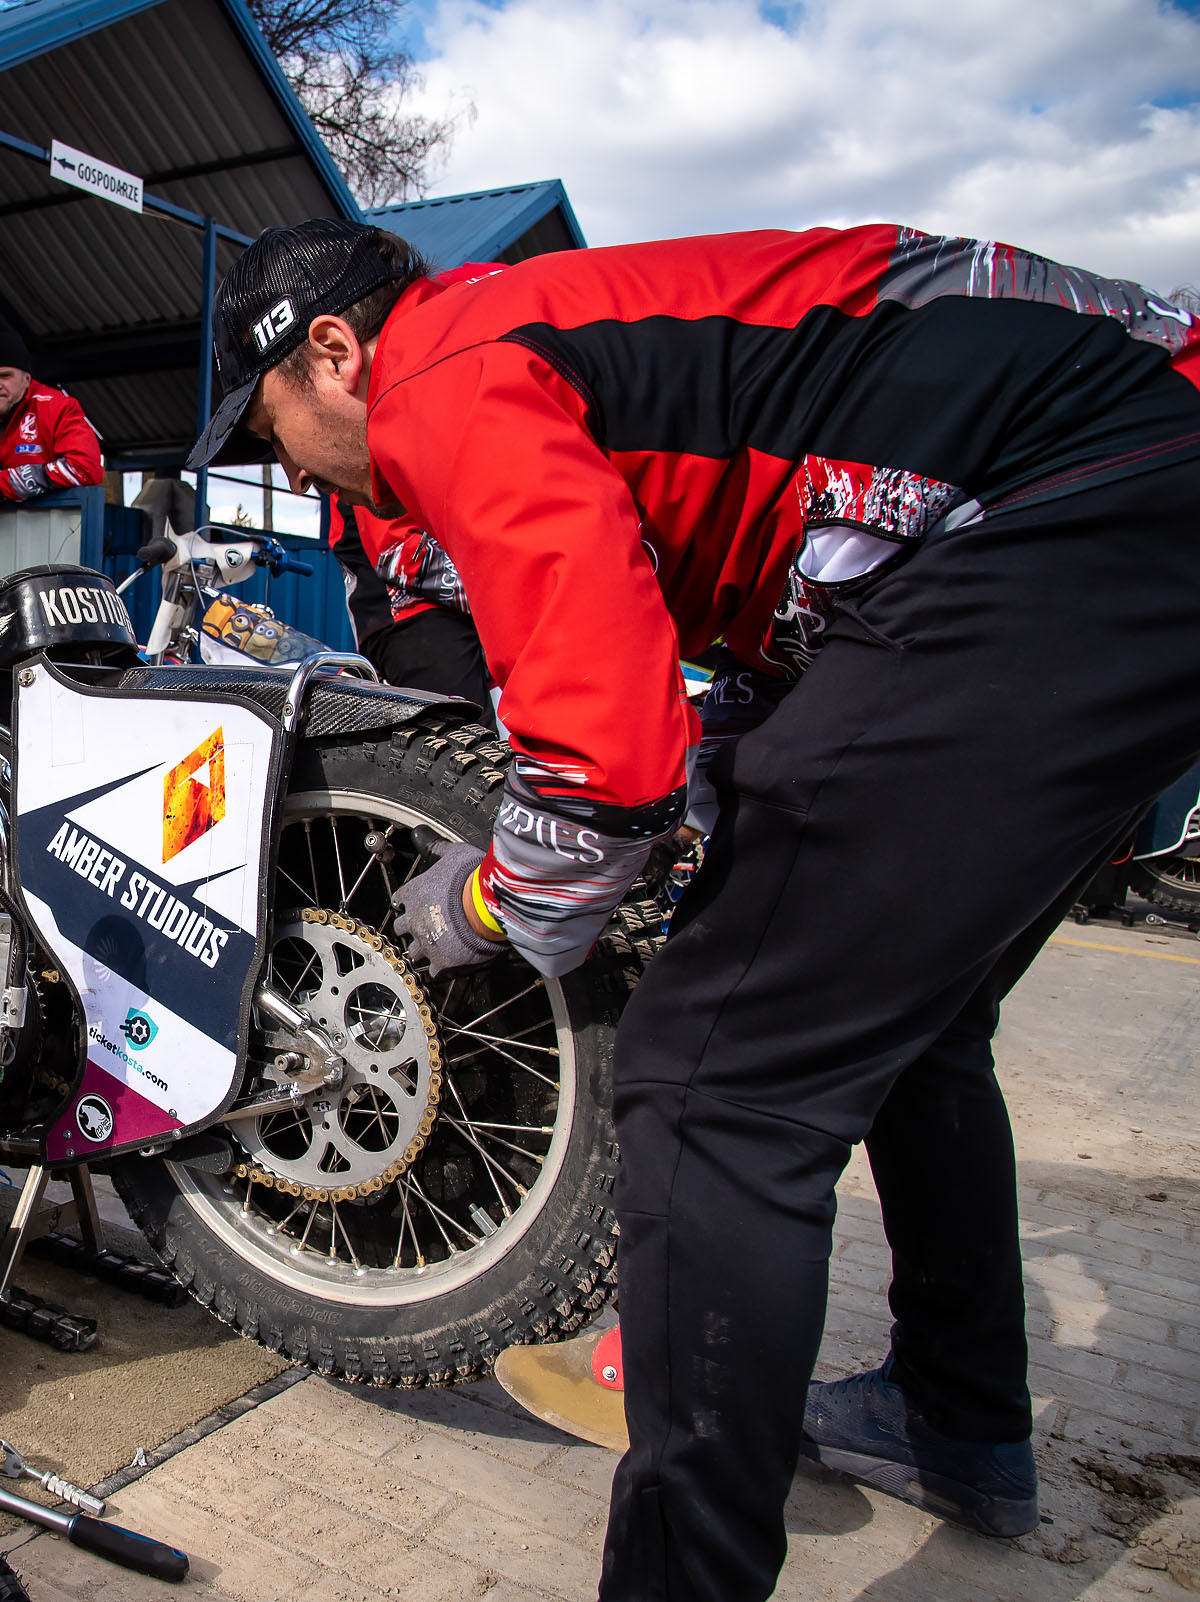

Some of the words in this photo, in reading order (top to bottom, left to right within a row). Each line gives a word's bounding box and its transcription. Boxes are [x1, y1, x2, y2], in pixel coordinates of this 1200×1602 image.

[78, 163, 139, 204] GOSPODARZE
[253, 298, 296, 350] 113
[46, 821, 128, 899] AMBER
[119, 870, 229, 970] STUDIOS
[88, 1027, 169, 1092] ticketkosta.com
